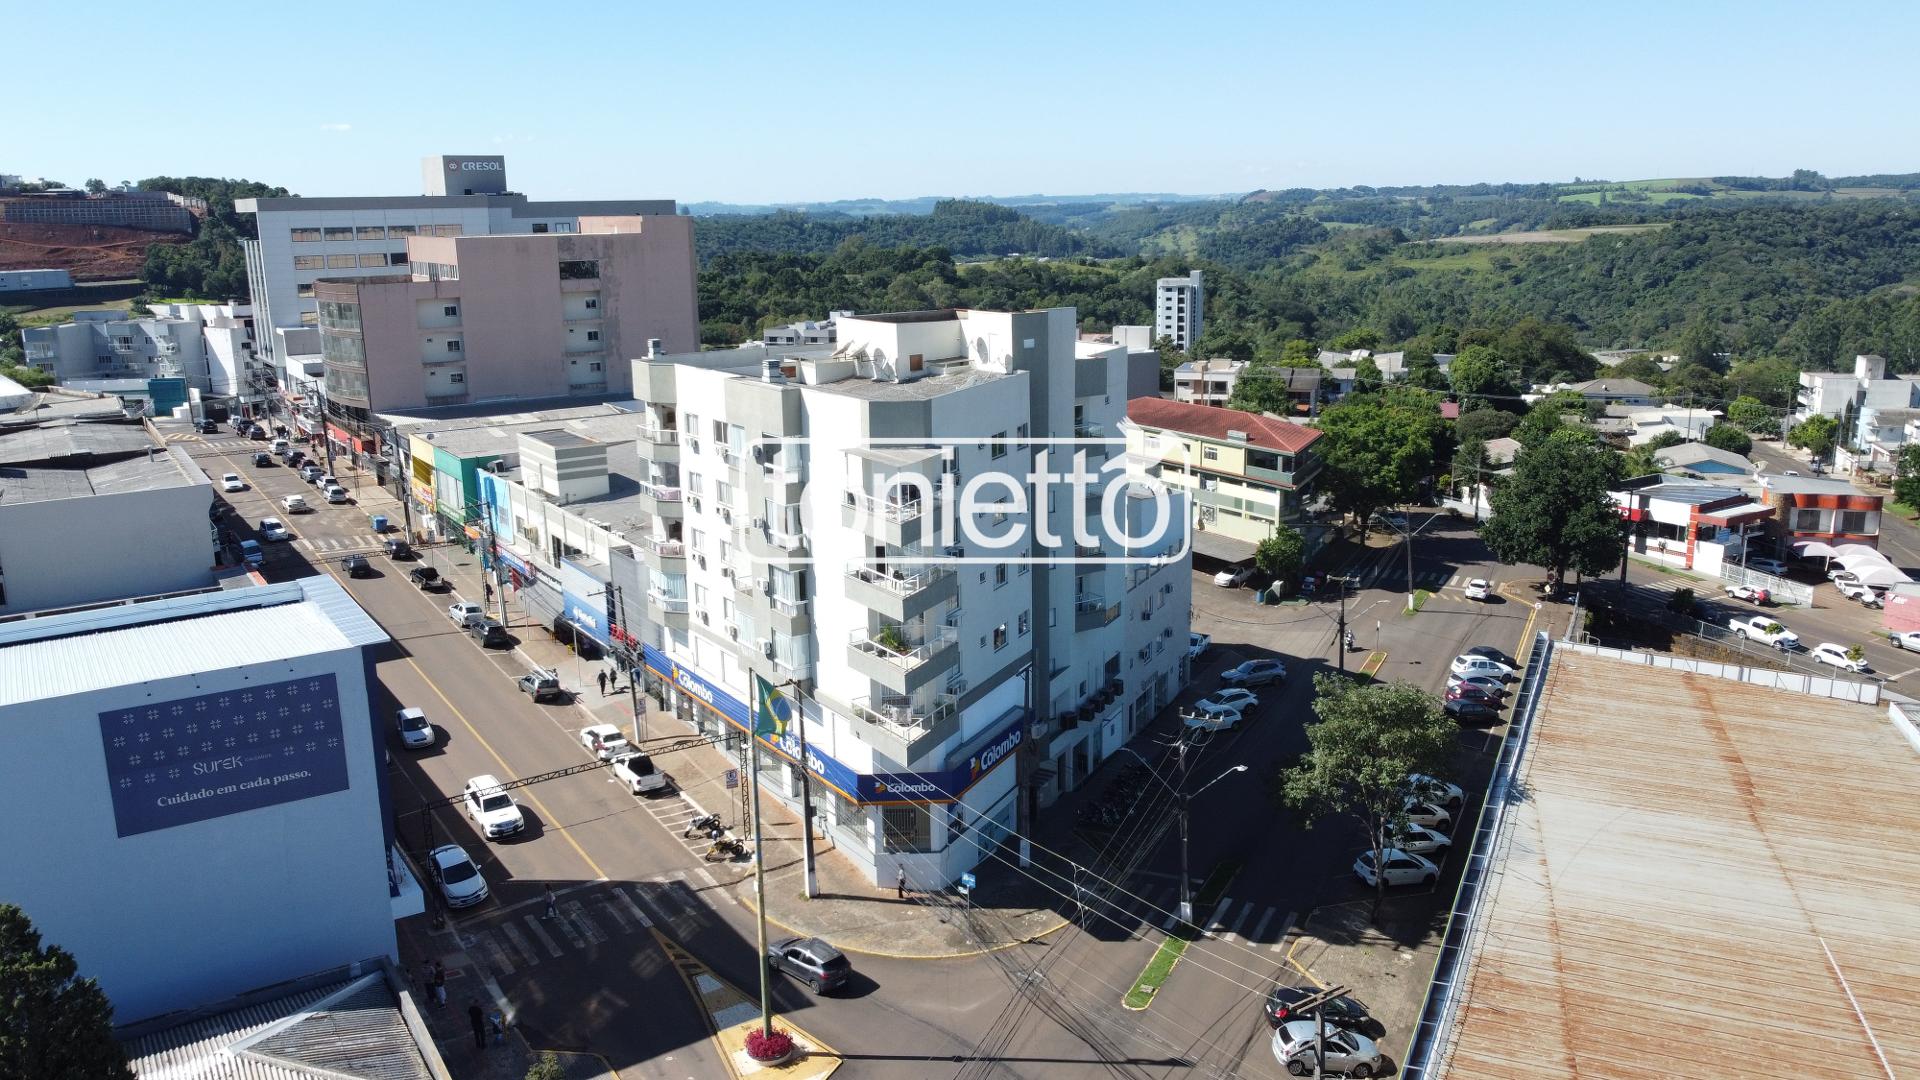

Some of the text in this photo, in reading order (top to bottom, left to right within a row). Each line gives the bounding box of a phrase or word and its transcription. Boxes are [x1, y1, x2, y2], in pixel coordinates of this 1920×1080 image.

[461, 161, 502, 171] CRESOL
[980, 730, 1021, 770] Colombo
[157, 770, 312, 807] Cuidado em cada passo.
[886, 783, 936, 793] Colombo
